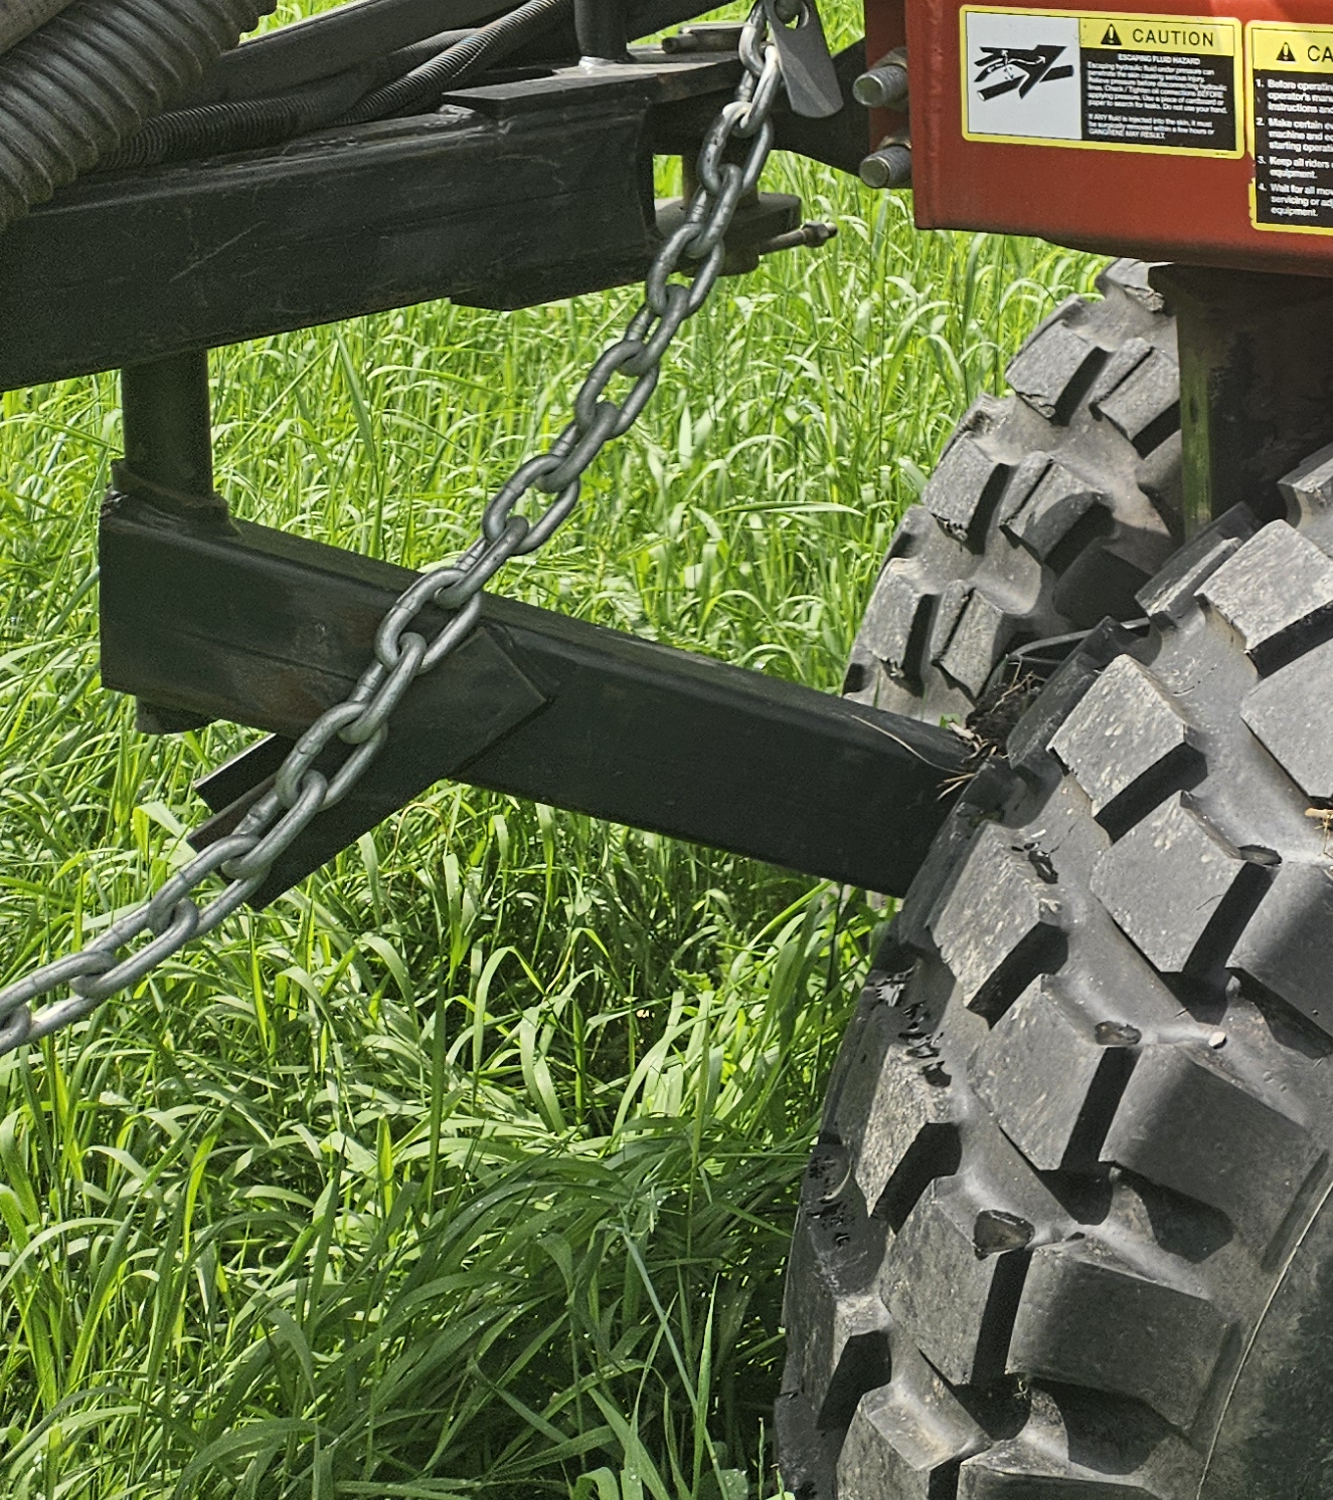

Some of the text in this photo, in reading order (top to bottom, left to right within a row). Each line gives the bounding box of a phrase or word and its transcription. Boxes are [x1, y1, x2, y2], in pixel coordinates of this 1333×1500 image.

[1132, 28, 1215, 48] CAUTION
[1255, 79, 1264, 87] 1.
[1267, 79, 1296, 89] Before
[1267, 91, 1310, 102] operator's
[1267, 102, 1318, 113] instructions
[1256, 117, 1264, 125] 2.
[1268, 118, 1292, 127] Make
[1293, 119, 1322, 129] certain
[1268, 130, 1304, 139] machine
[1306, 132, 1322, 140] and
[1268, 141, 1301, 152] starting
[1257, 156, 1266, 164] 3.
[1269, 156, 1292, 167] Keep
[1293, 158, 1303, 166] all
[1305, 158, 1329, 168] riders
[1269, 168, 1317, 180] equipment.
[1258, 183, 1266, 191] 4.
[1270, 184, 1289, 193] Wait
[1290, 185, 1303, 194] for
[1304, 186, 1315, 194] all
[1270, 196, 1308, 207] servicing
[1270, 206, 1318, 217] equipment.
